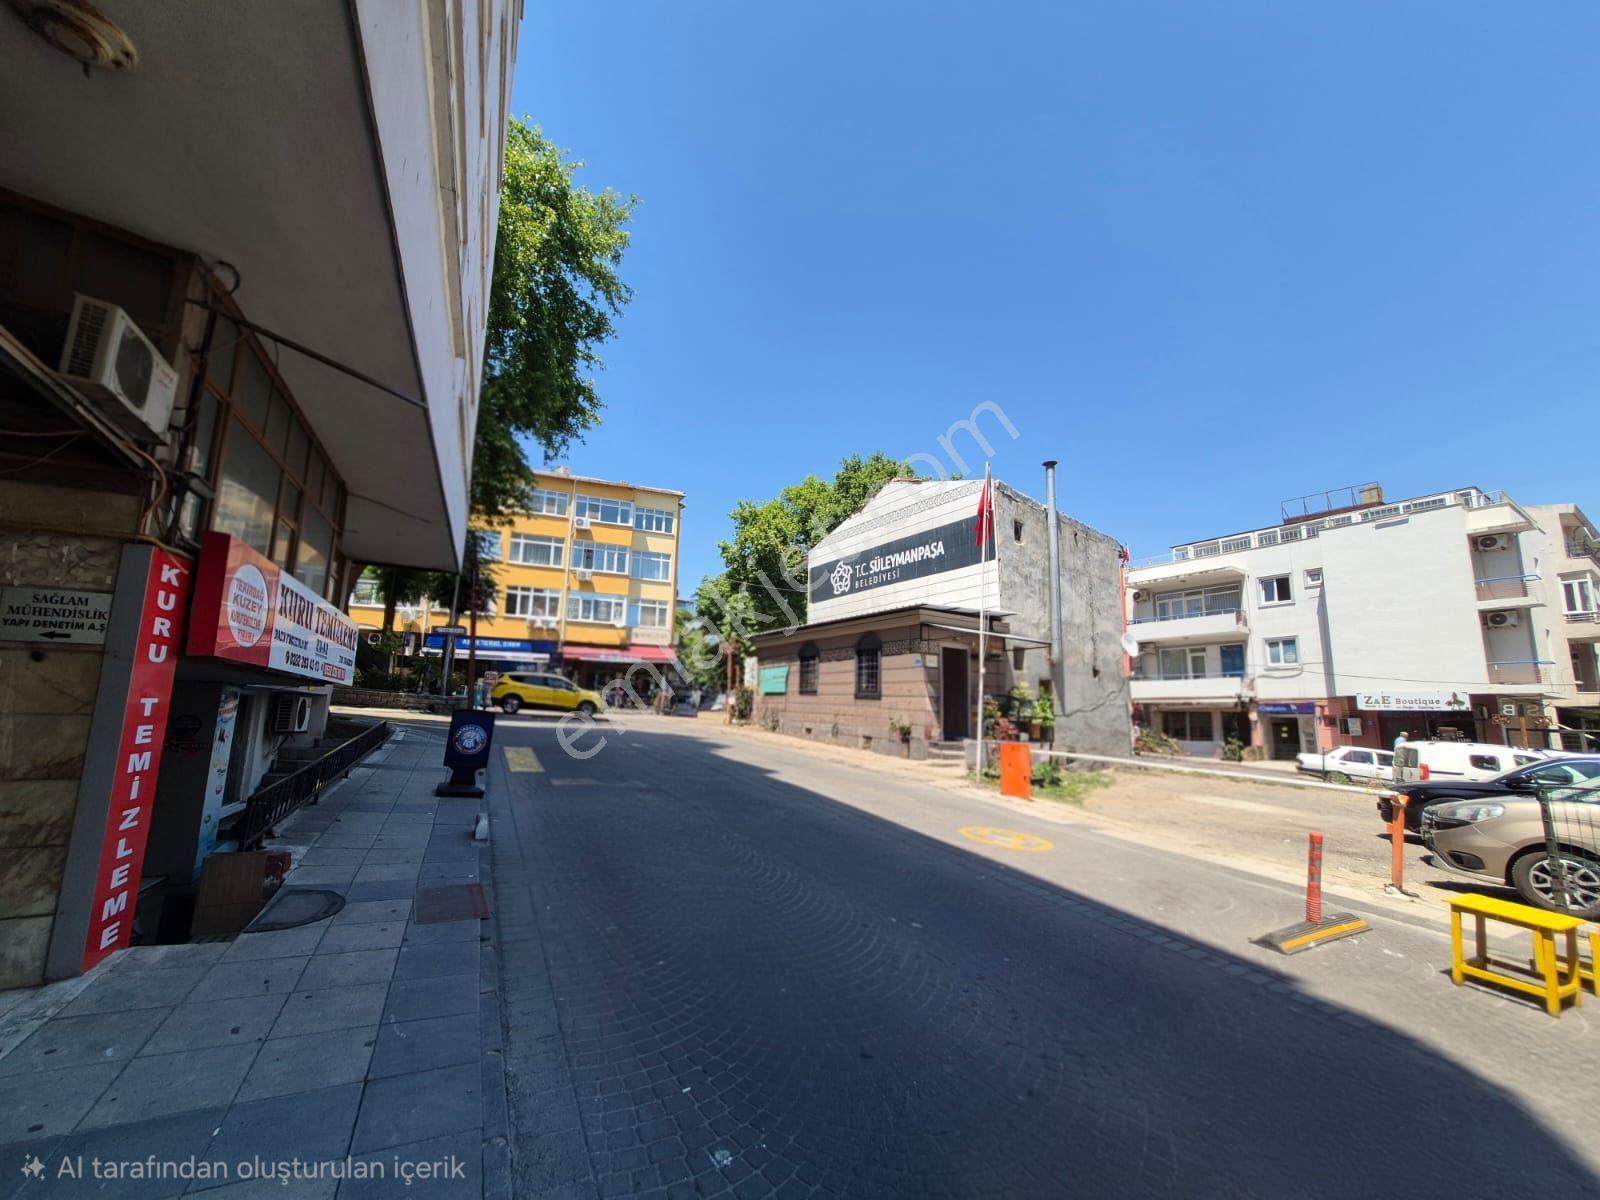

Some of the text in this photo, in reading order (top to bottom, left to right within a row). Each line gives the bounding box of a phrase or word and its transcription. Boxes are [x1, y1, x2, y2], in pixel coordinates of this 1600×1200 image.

[855, 541, 945, 578] T.C. SÜLEYMANPAŞA
[855, 568, 900, 589] BELEDİYESİ
[31, 593, 89, 607] SAĞLAM
[232, 592, 264, 615] KUZEY
[279, 584, 314, 631] KURU
[7, 604, 108, 621] MÜHENDİSLİK
[148, 564, 180, 664] KURU
[2, 618, 29, 628] YAPI
[33, 619, 85, 631] DENETİM
[1395, 697, 1441, 707] Boutique
[99, 697, 159, 950] TEMİZLEME
